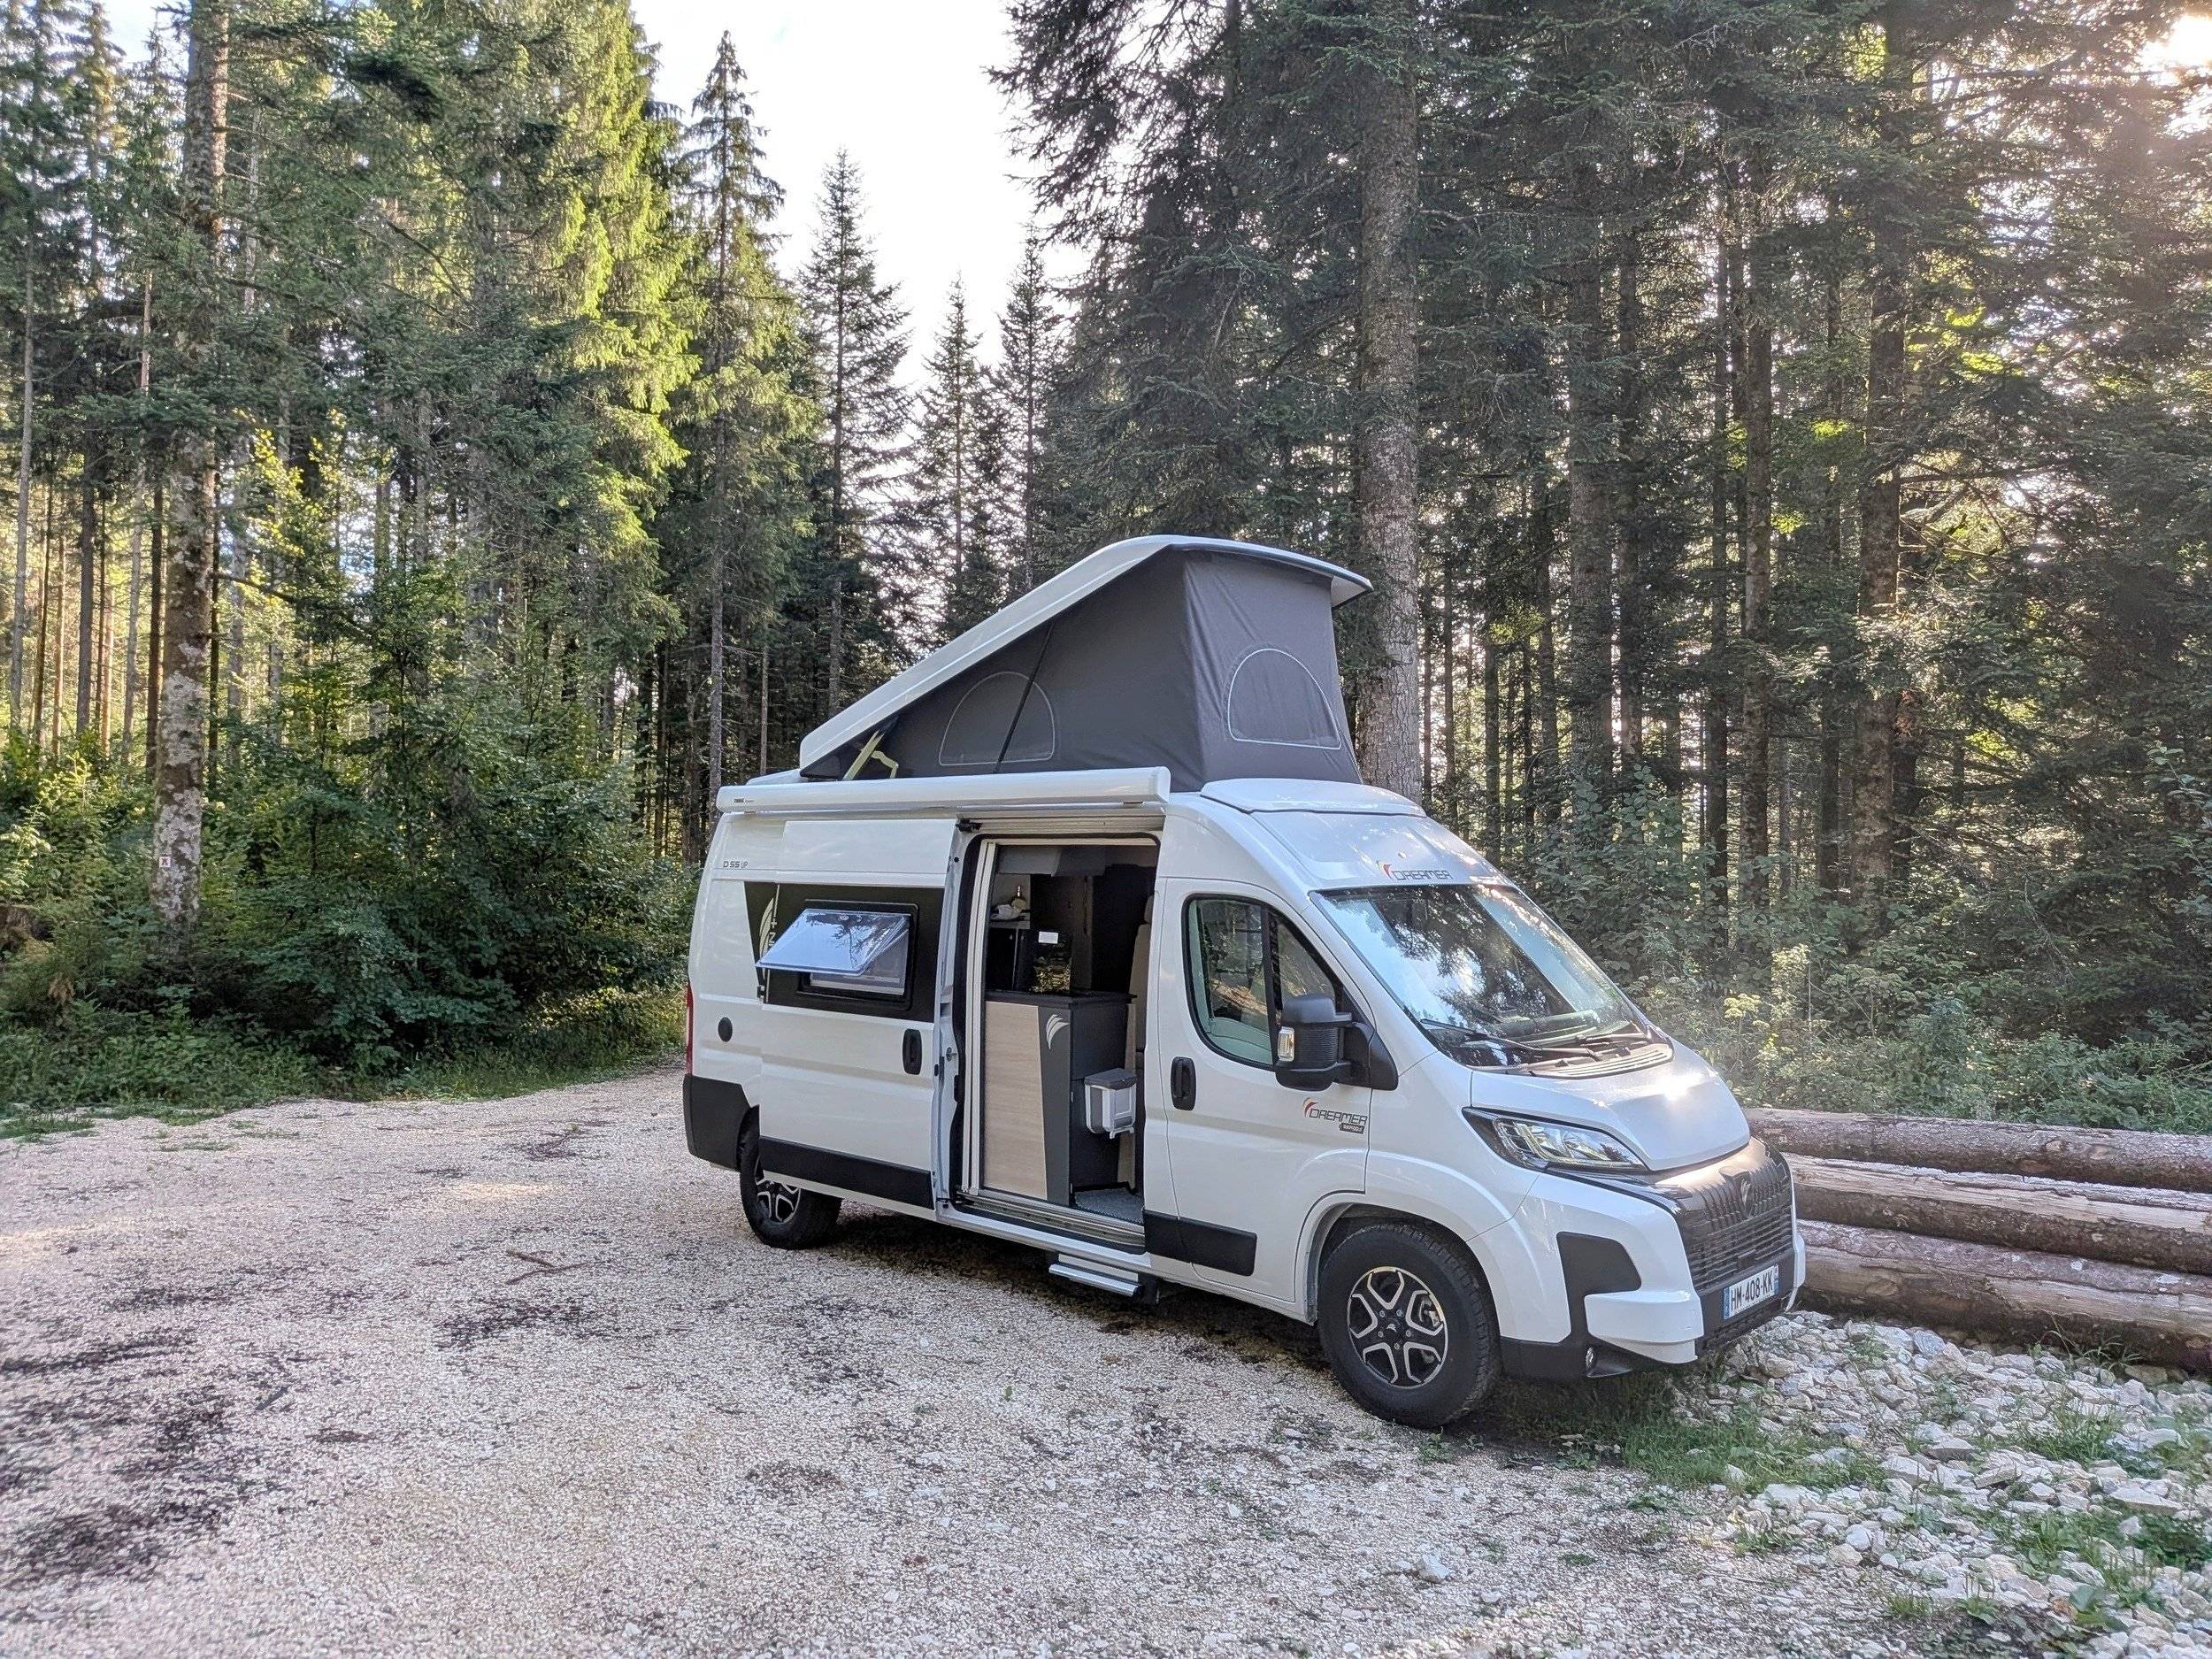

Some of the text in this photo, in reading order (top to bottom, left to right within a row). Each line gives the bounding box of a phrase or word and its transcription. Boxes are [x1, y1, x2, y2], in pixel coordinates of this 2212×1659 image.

[1392, 870, 1454, 881] DREAMER
[1309, 1108, 1368, 1125] DREAMER
[1731, 1270, 1773, 1311] HM-408-KK
